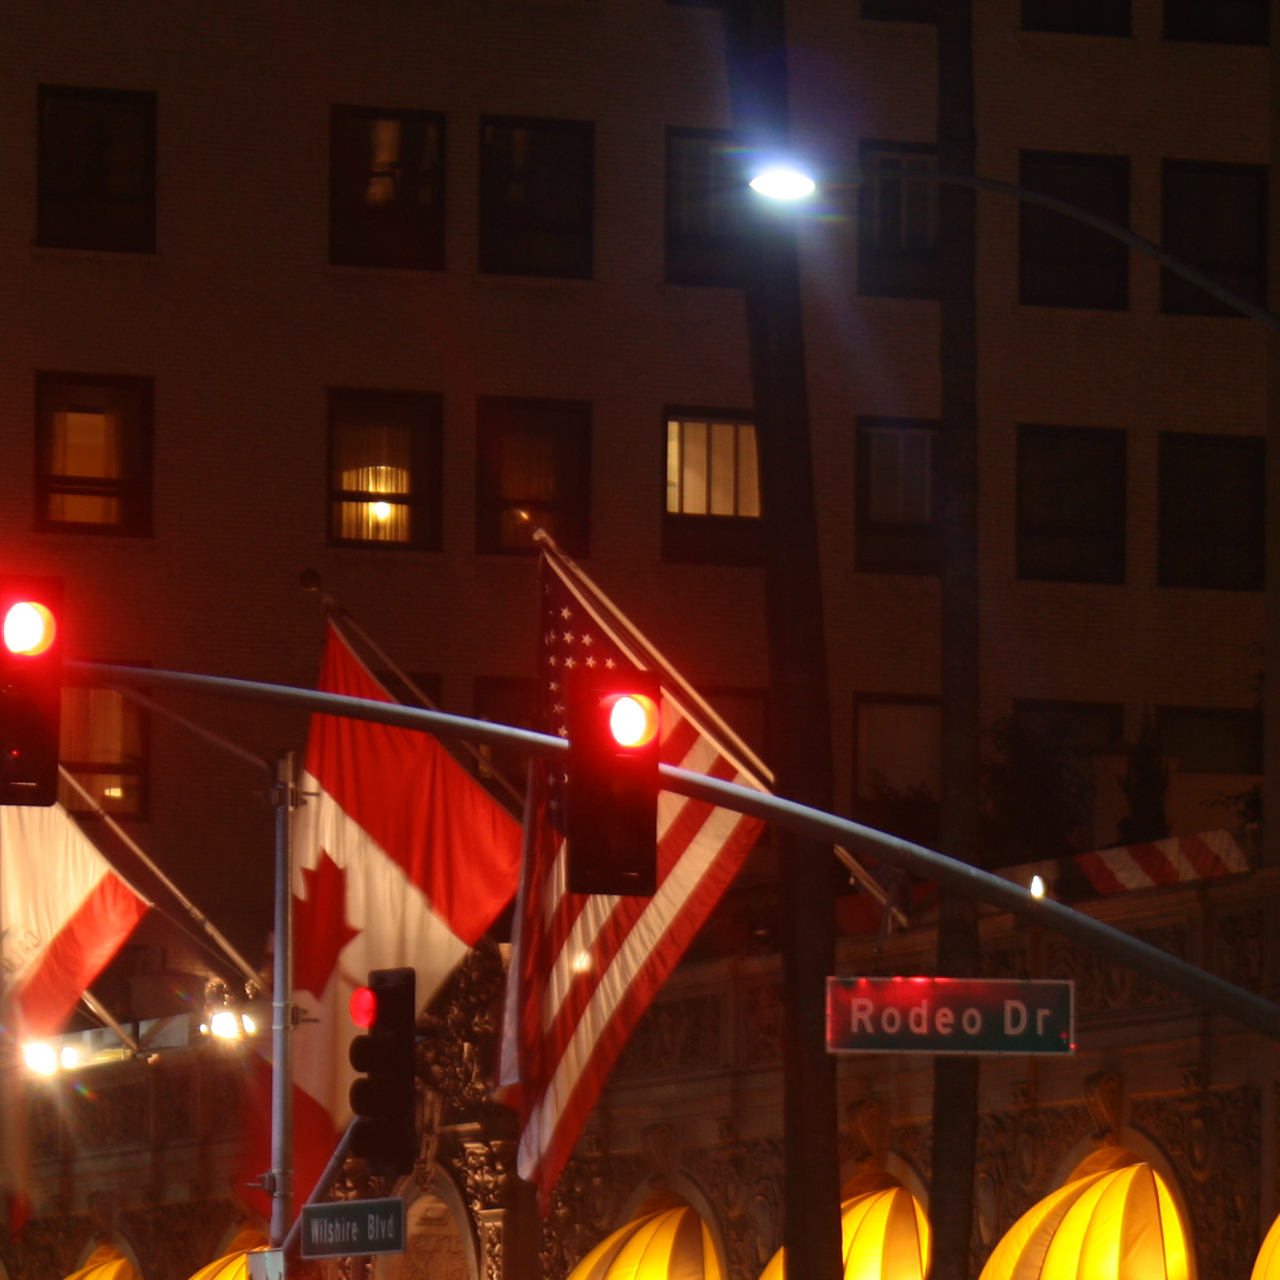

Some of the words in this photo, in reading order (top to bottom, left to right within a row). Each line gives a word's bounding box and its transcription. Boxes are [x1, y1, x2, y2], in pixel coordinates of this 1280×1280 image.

[850, 998, 982, 1035] Rodeo
[1003, 1000, 1052, 1036] Dr
[310, 1217, 359, 1243] Wilshire
[367, 1213, 395, 1240] Blvd
